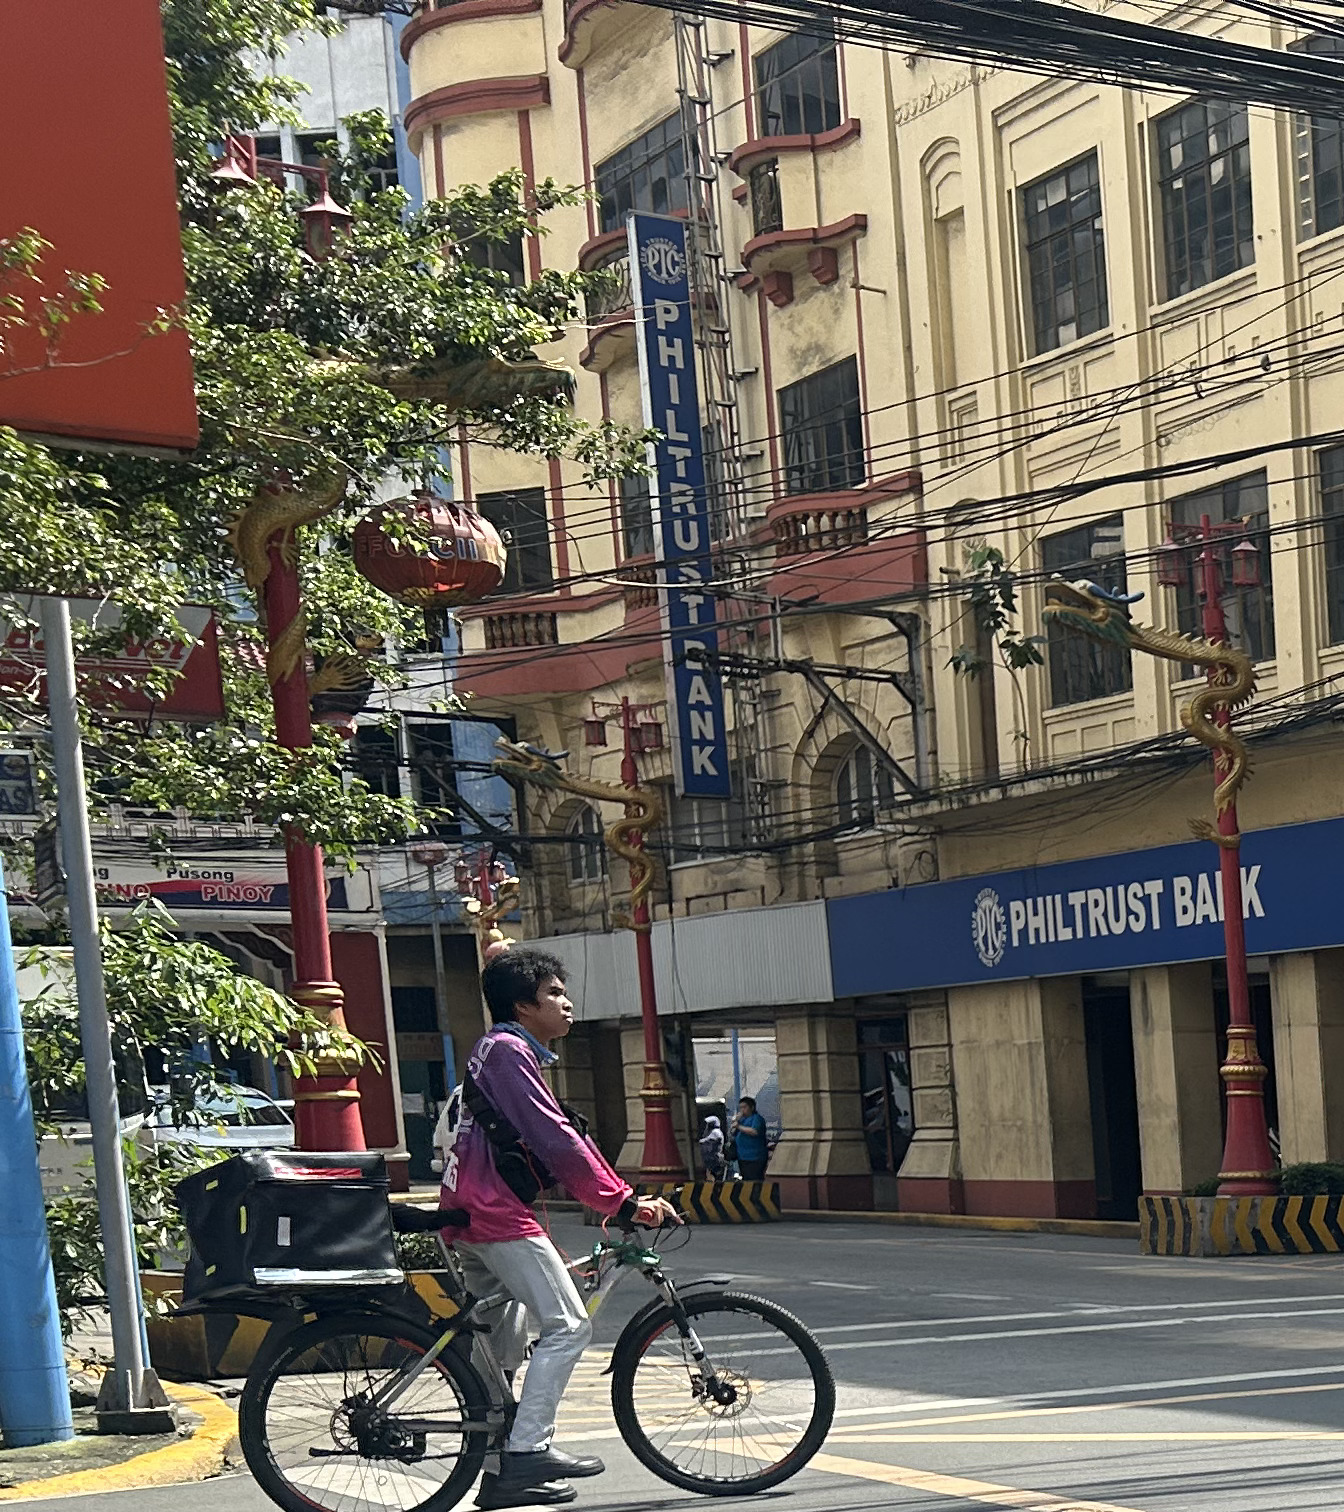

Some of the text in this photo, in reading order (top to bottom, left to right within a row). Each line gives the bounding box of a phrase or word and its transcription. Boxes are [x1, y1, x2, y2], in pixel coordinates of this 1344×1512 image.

[646, 243, 681, 280] PTC
[166, 866, 234, 883] Pusong
[202, 884, 275, 903] PINOY
[1010, 879, 1163, 947] PHILTRUST
